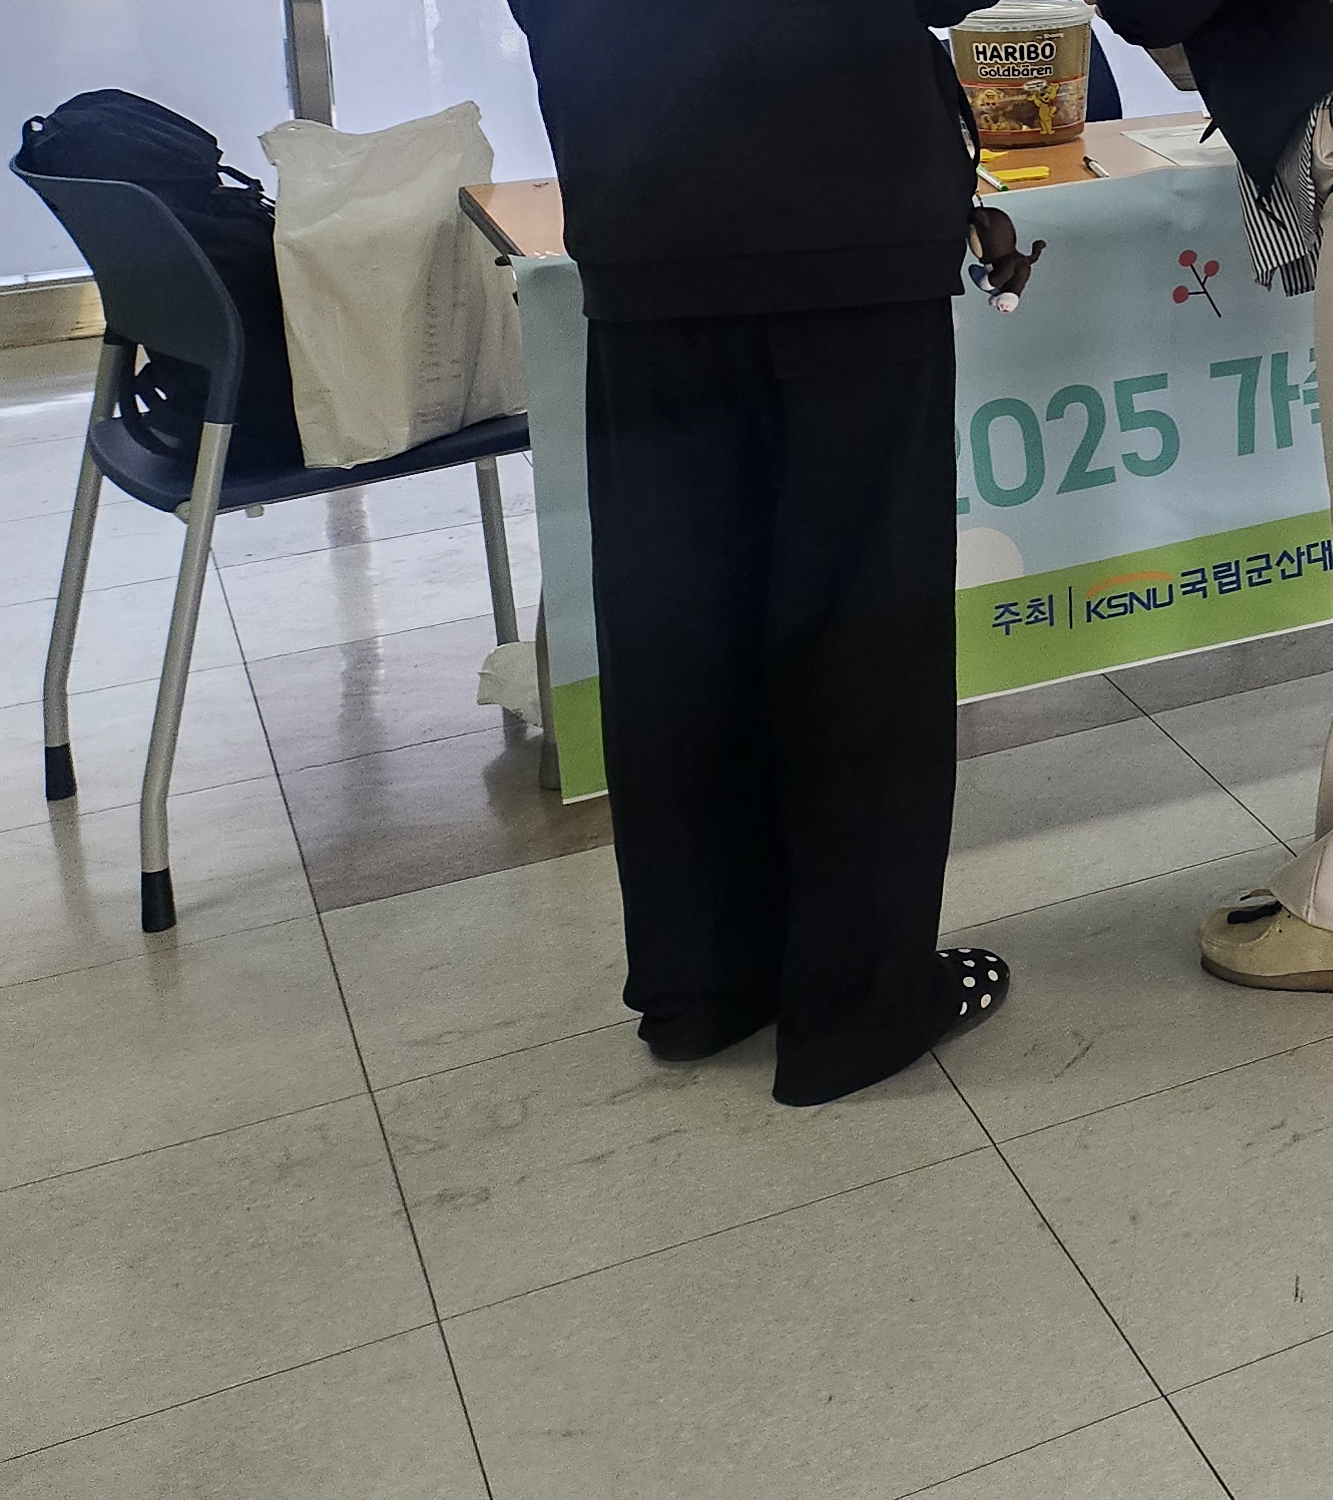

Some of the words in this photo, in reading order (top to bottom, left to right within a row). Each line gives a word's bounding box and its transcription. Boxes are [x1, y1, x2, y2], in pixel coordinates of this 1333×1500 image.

[973, 41, 1056, 63] HARIBO
[978, 64, 1053, 78] Goldbären
[956, 372, 1181, 516] 025
[992, 594, 1055, 636] 주최
[1085, 583, 1174, 623] KSNU
